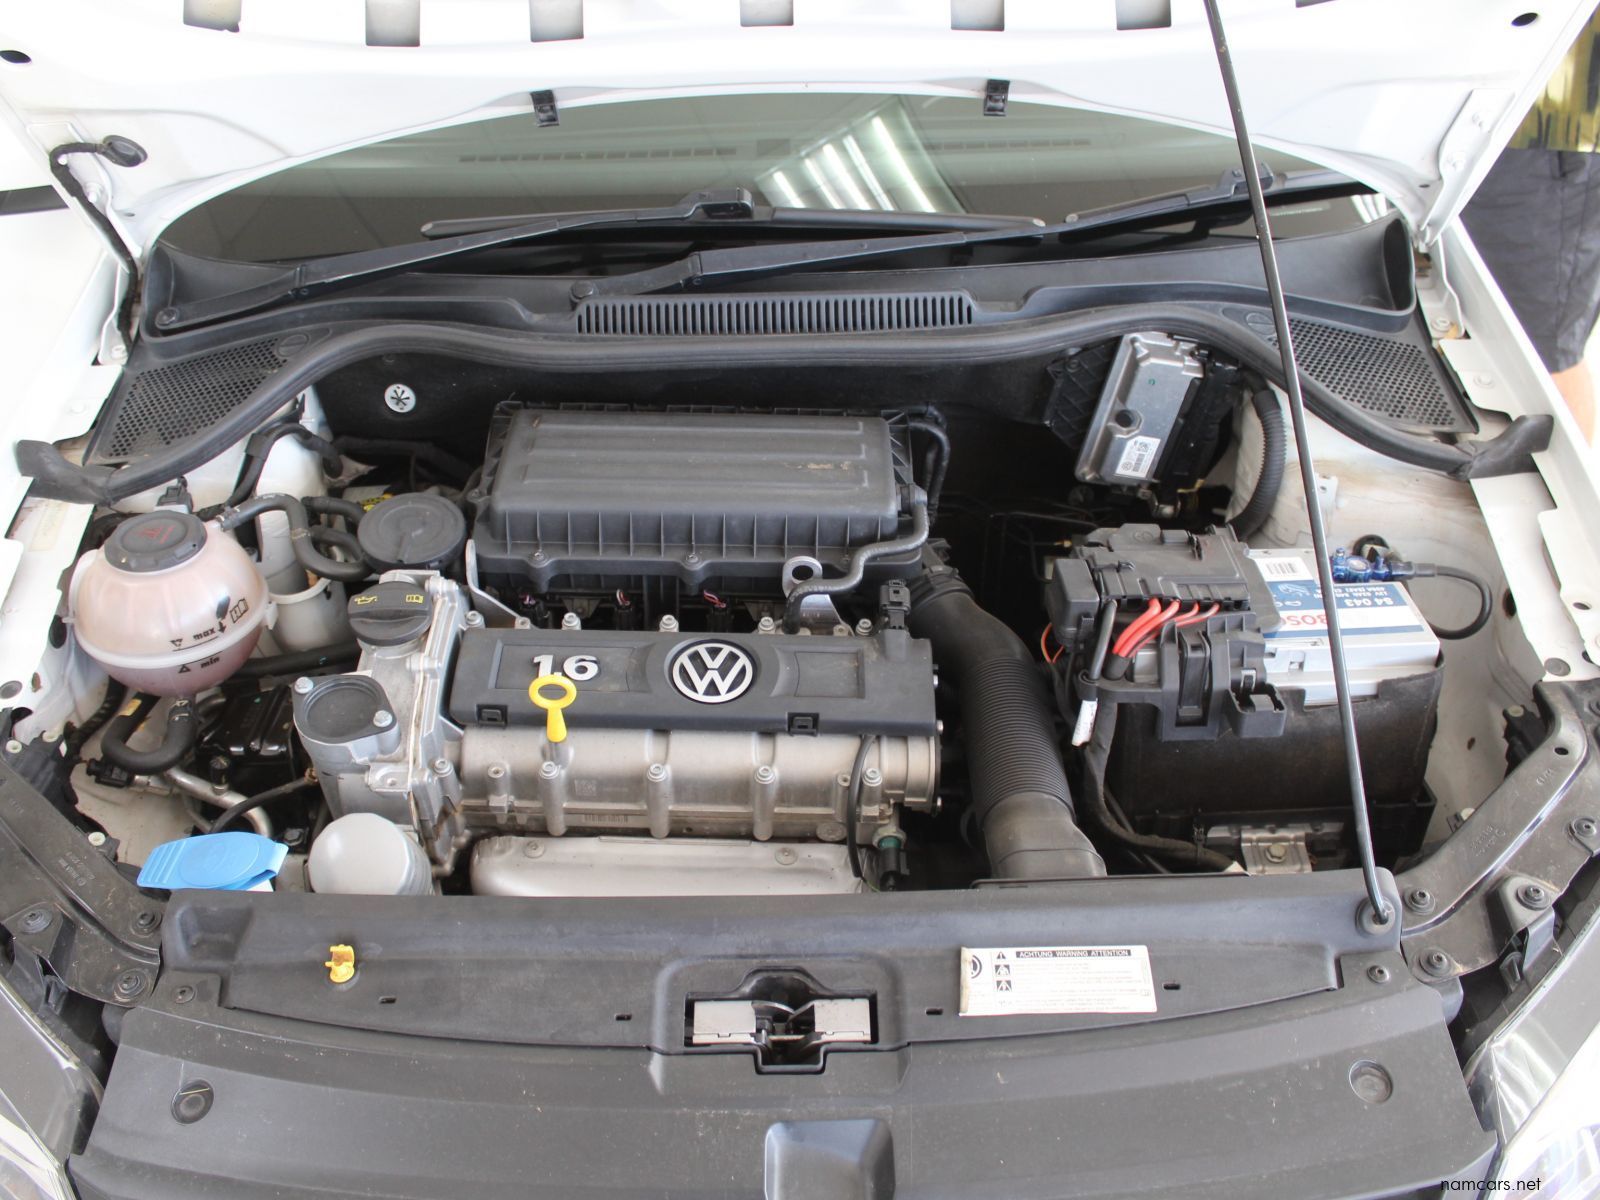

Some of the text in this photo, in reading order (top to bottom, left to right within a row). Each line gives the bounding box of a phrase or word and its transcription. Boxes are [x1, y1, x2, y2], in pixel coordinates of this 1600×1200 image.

[1344, 598, 1372, 606] 043
[193, 627, 216, 641] max
[201, 656, 221, 668] min
[533, 654, 599, 681] 1.6
[1091, 949, 1128, 957] ATTENTION
